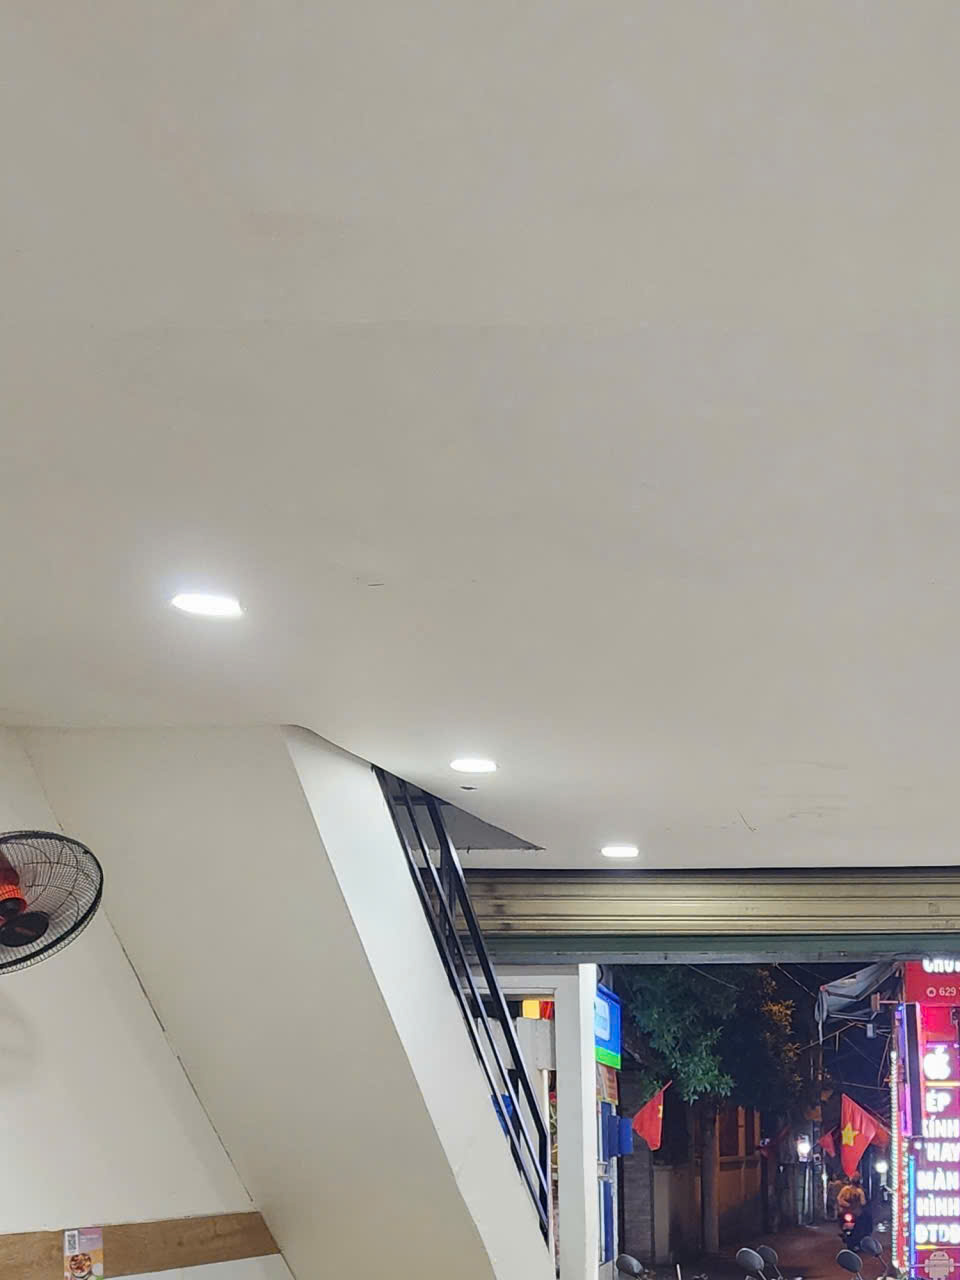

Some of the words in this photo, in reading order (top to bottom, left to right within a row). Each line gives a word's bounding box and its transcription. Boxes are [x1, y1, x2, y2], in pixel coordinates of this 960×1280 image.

[939, 986, 956, 997] 629
[924, 1142, 960, 1162] HAY
[916, 1167, 960, 1191] MÀN
[916, 1194, 960, 1217] HÌNH
